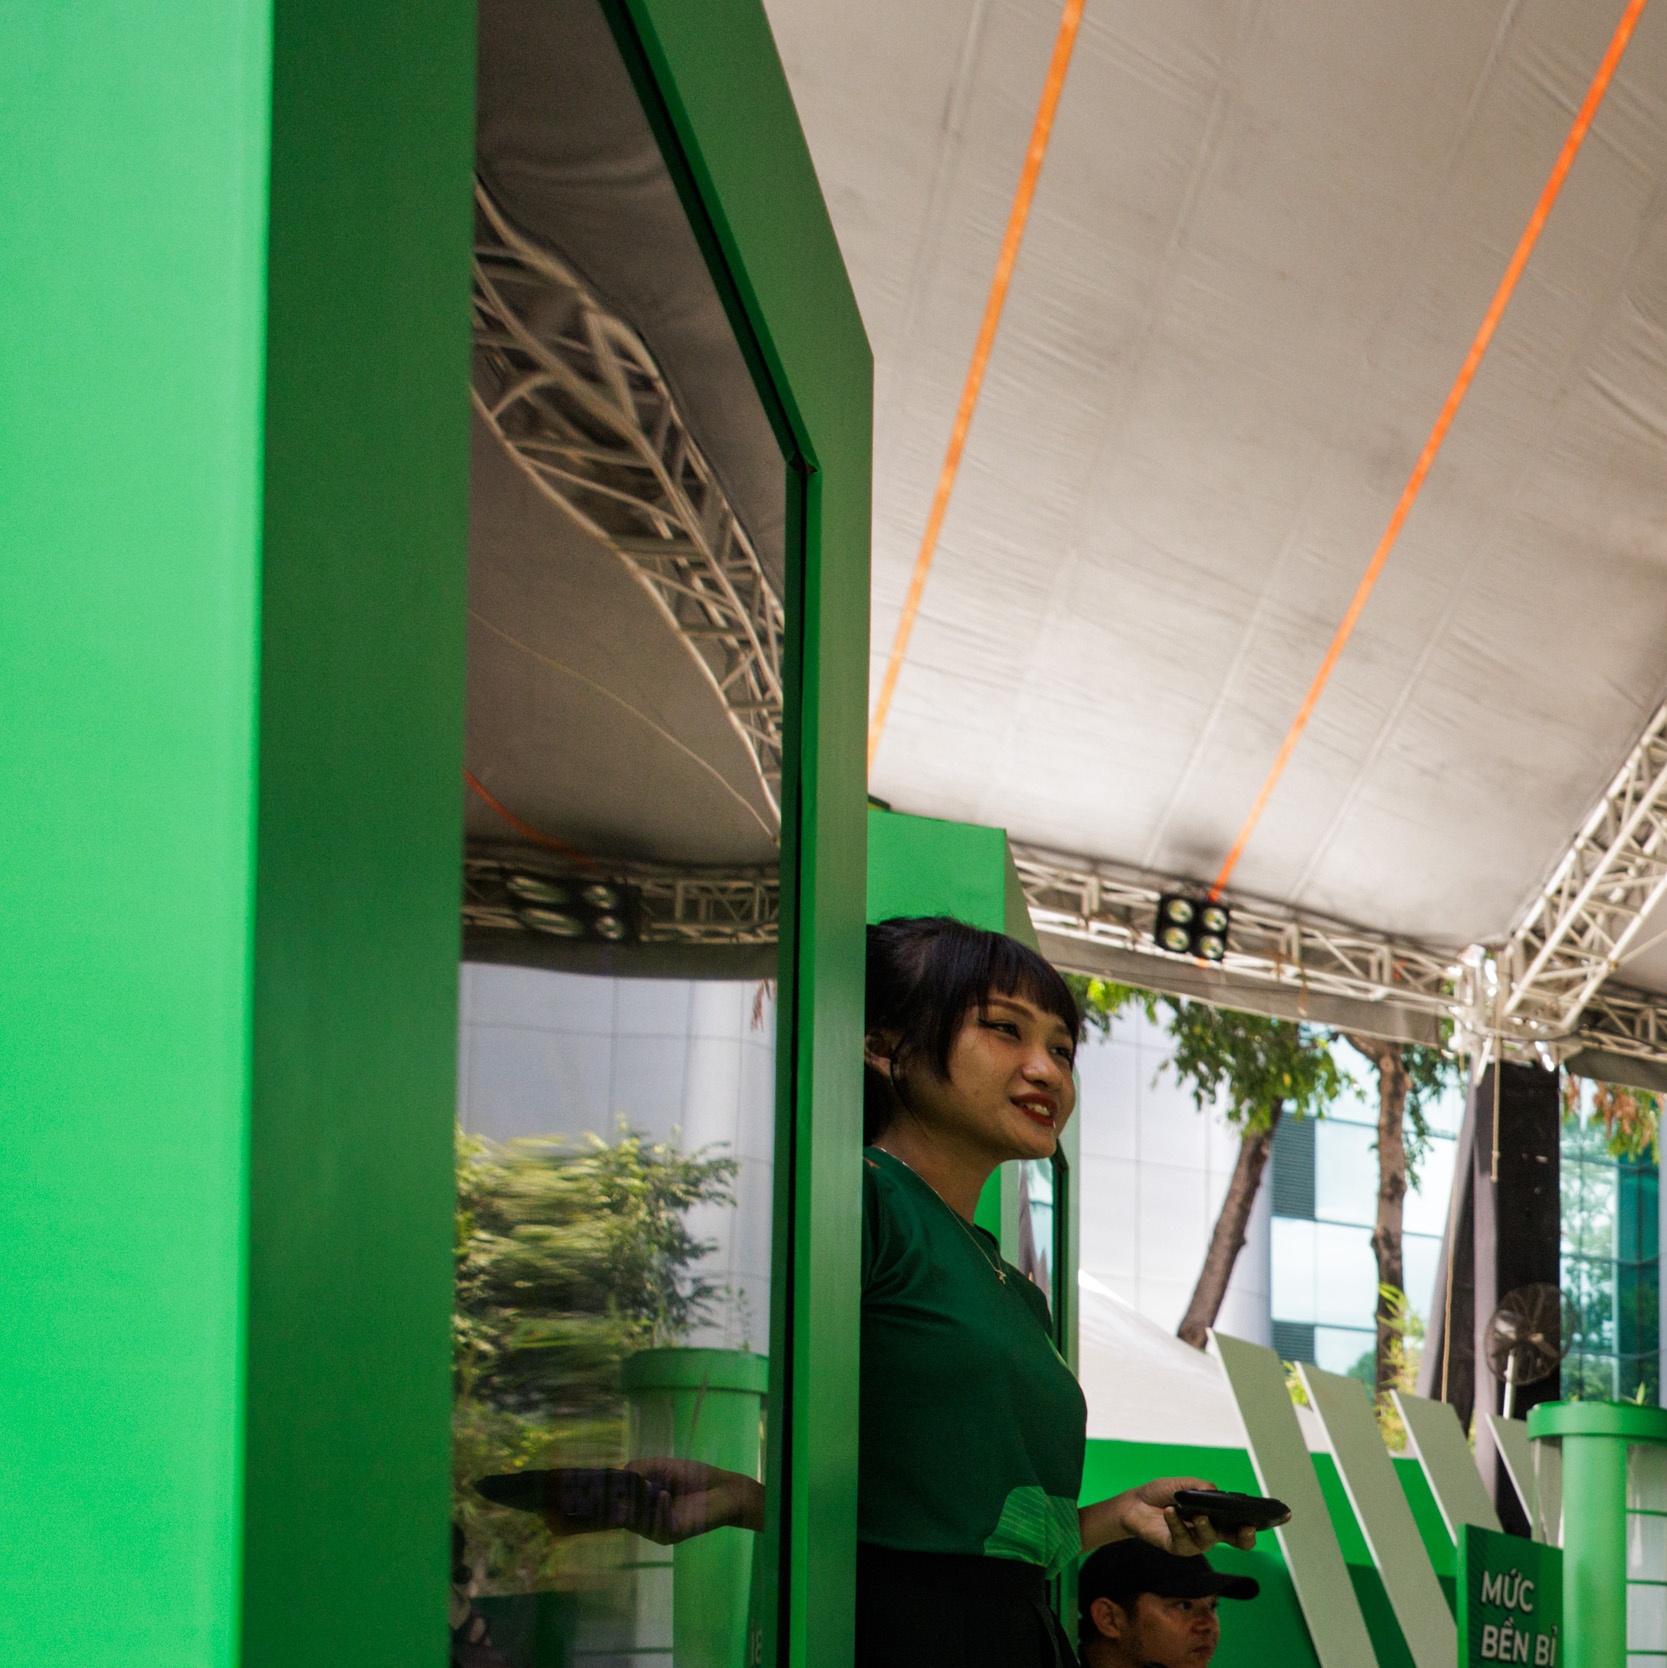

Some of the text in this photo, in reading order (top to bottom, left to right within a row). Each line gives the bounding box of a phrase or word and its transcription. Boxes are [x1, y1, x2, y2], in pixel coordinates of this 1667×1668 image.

[1480, 1568, 1535, 1614] MỨC
[1480, 1616, 1557, 1668] BỀN BỈ
